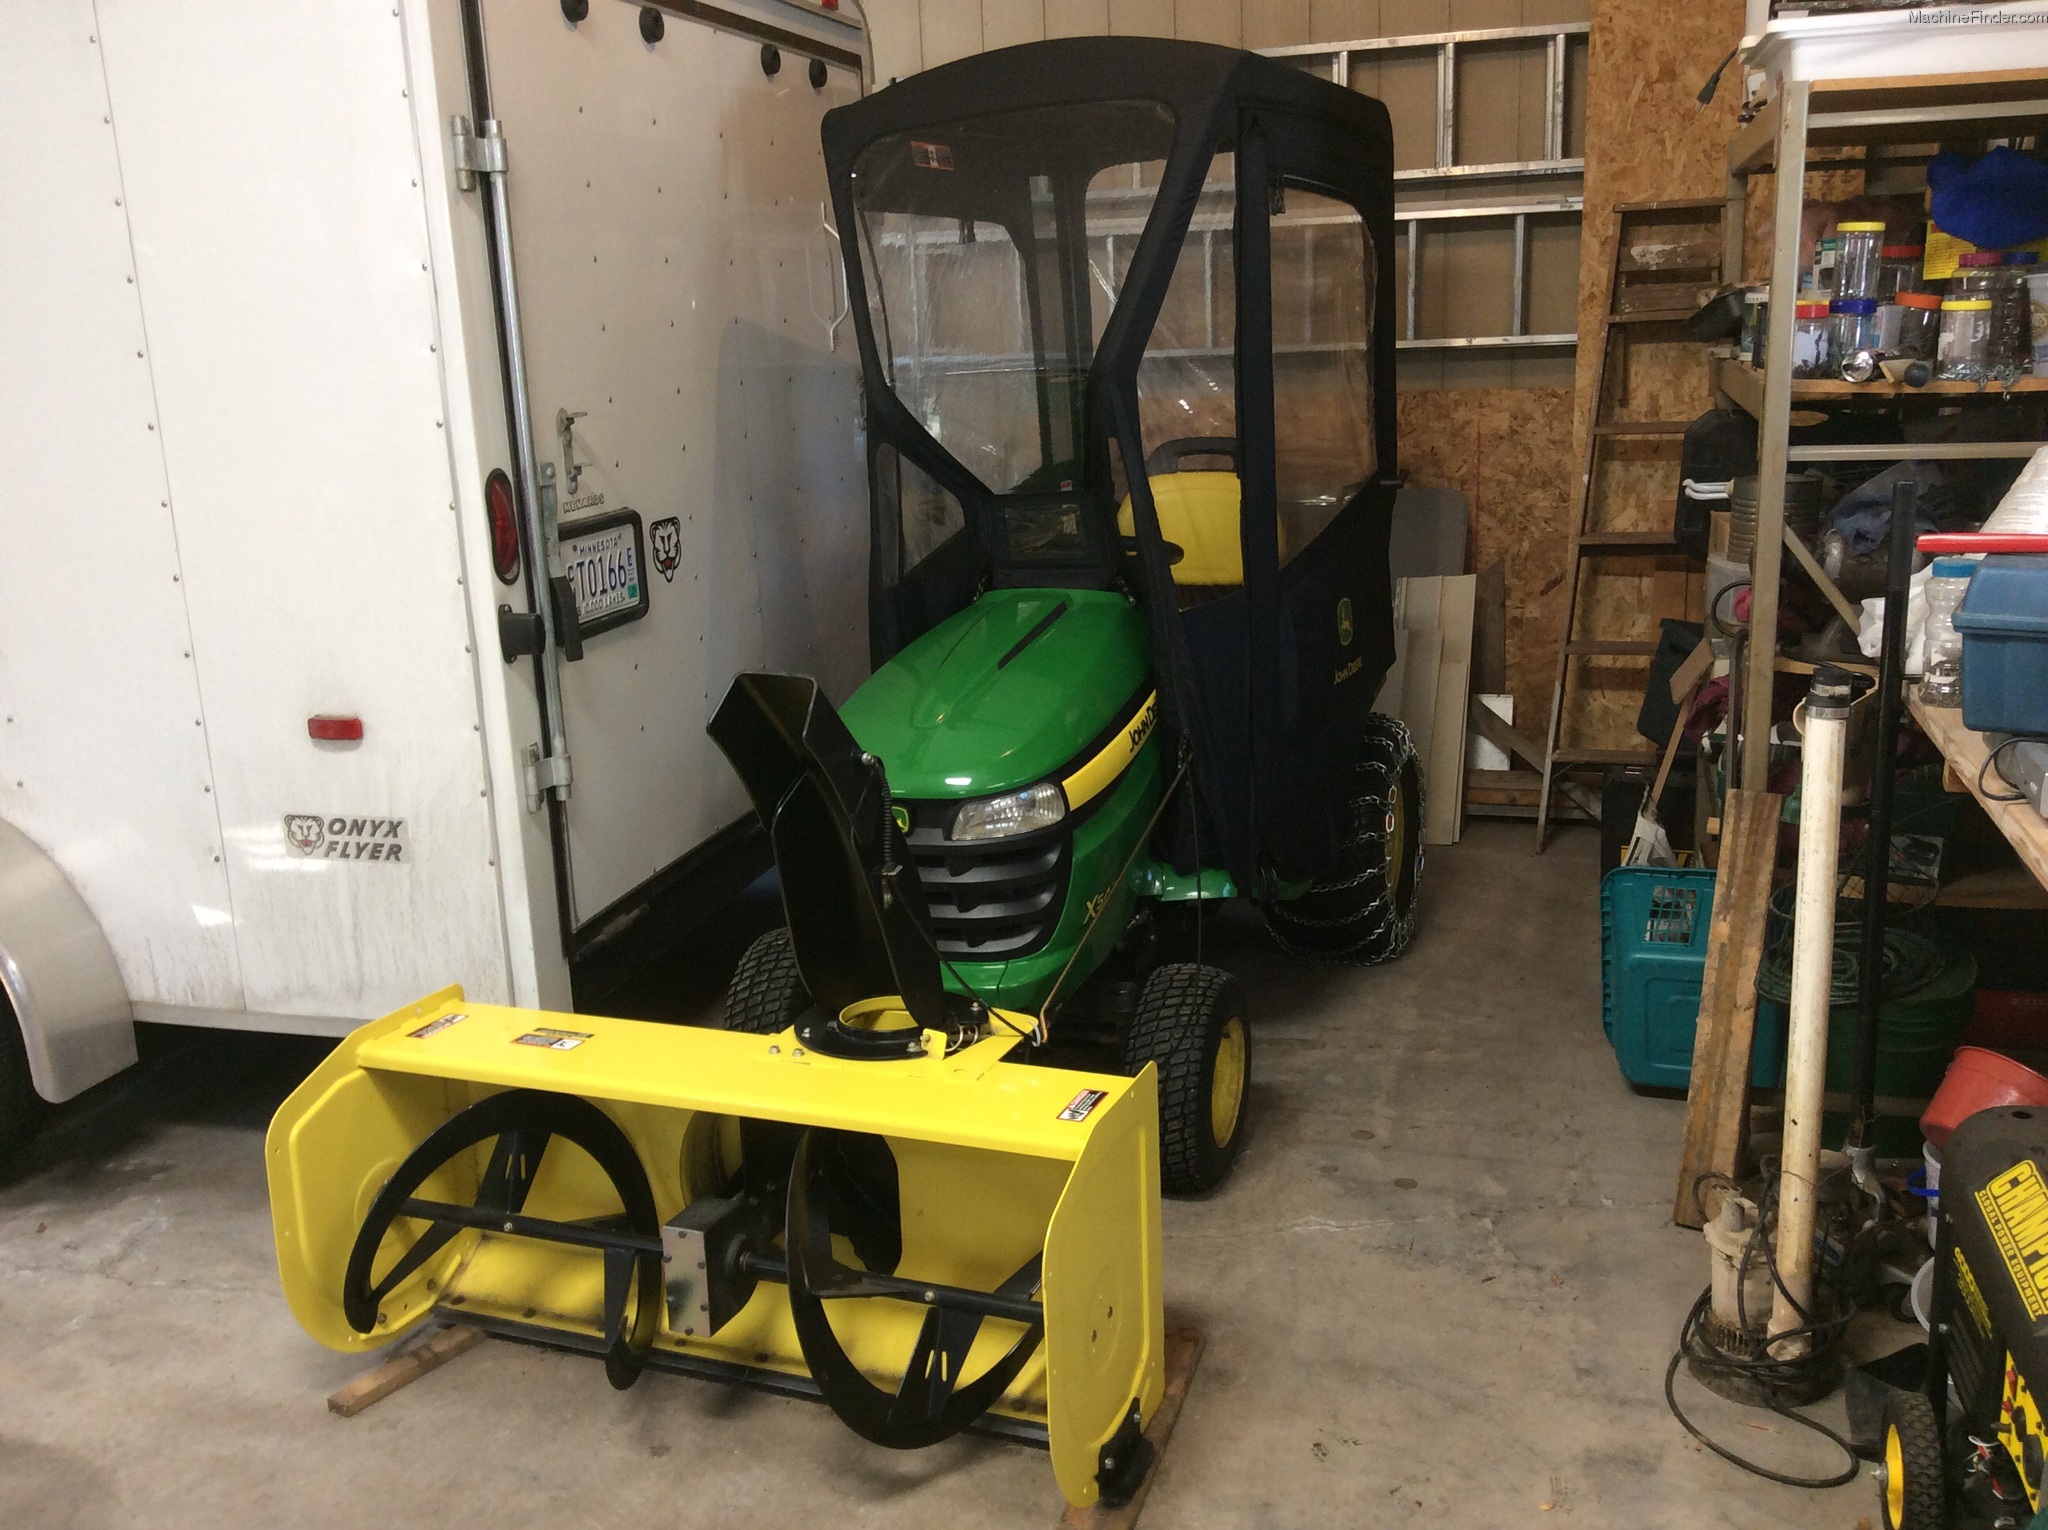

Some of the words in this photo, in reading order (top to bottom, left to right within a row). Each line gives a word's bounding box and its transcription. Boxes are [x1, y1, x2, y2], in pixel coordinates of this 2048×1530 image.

[579, 536, 618, 557] MINNESOTA
[1128, 714, 1150, 753] JOHN
[328, 817, 403, 839] ONYX
[324, 840, 403, 862] FLYER
[1978, 1189, 1999, 1224] GLOBAL
[1994, 1223, 2016, 1258] POWER
[2010, 1257, 2044, 1317] EQUIPMENT
